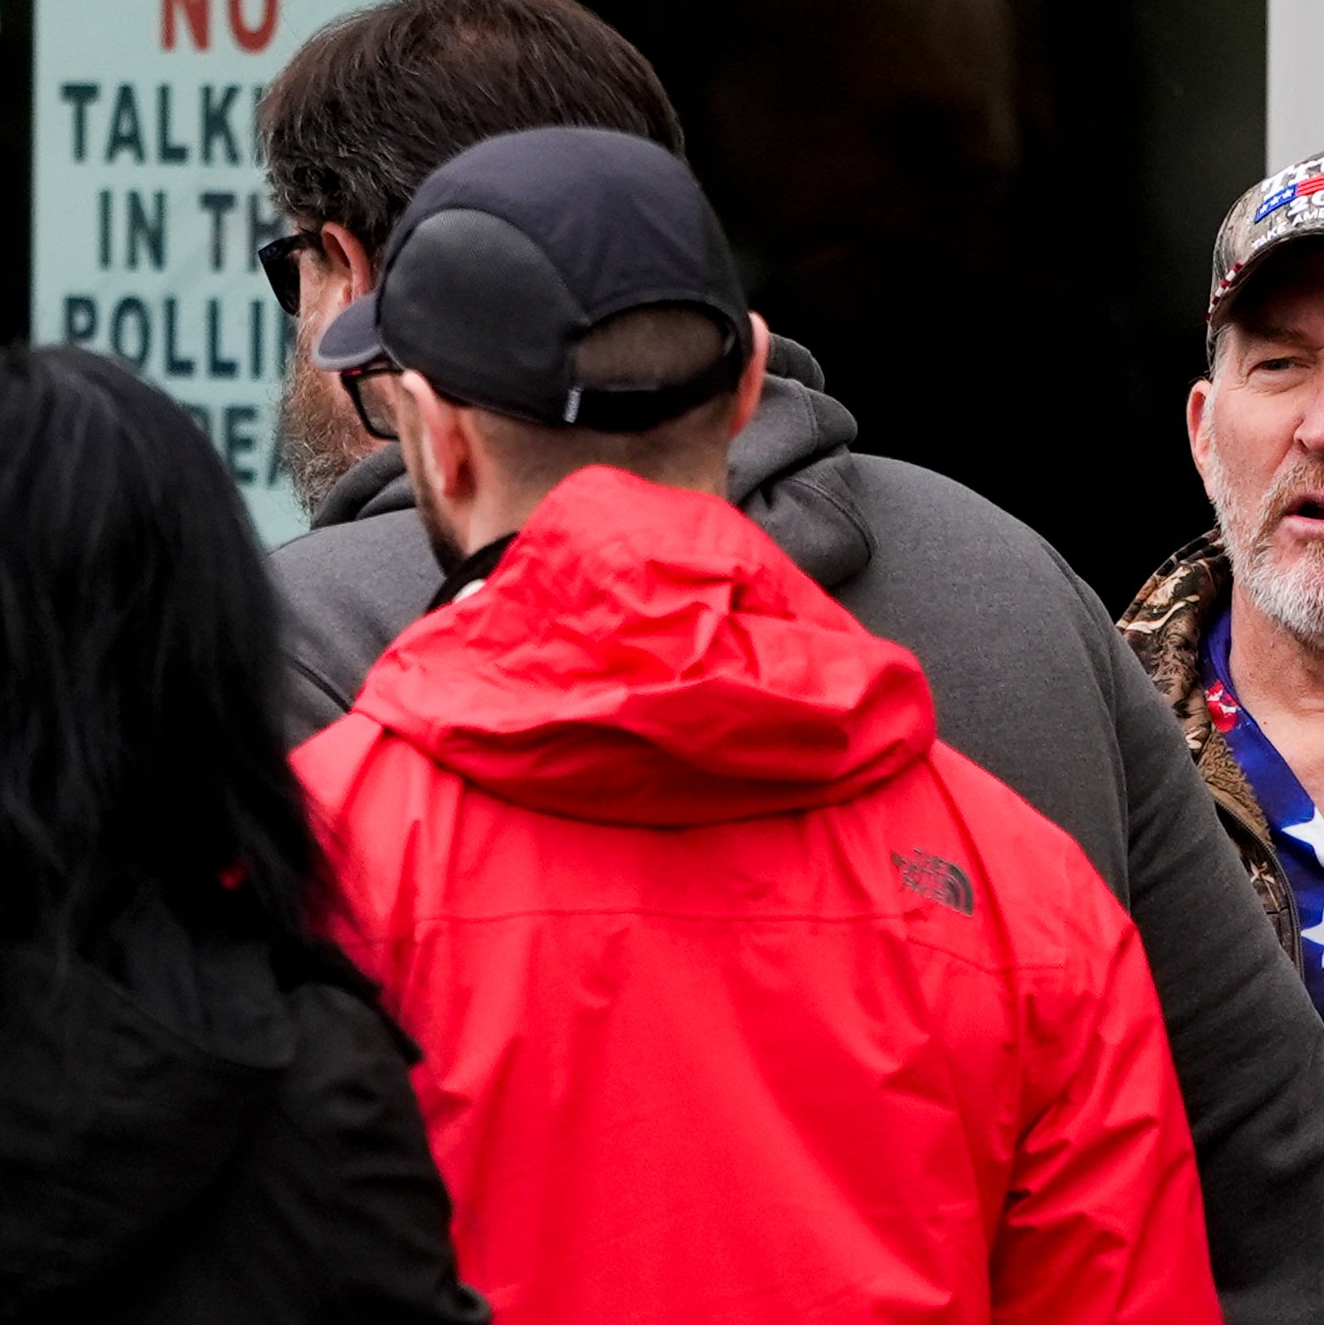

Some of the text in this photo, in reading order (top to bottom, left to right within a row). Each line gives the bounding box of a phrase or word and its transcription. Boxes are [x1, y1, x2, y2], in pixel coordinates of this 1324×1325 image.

[98, 188, 287, 274] IN TH
[1251, 218, 1289, 250] TAKE
[63, 294, 293, 381] POLLI
